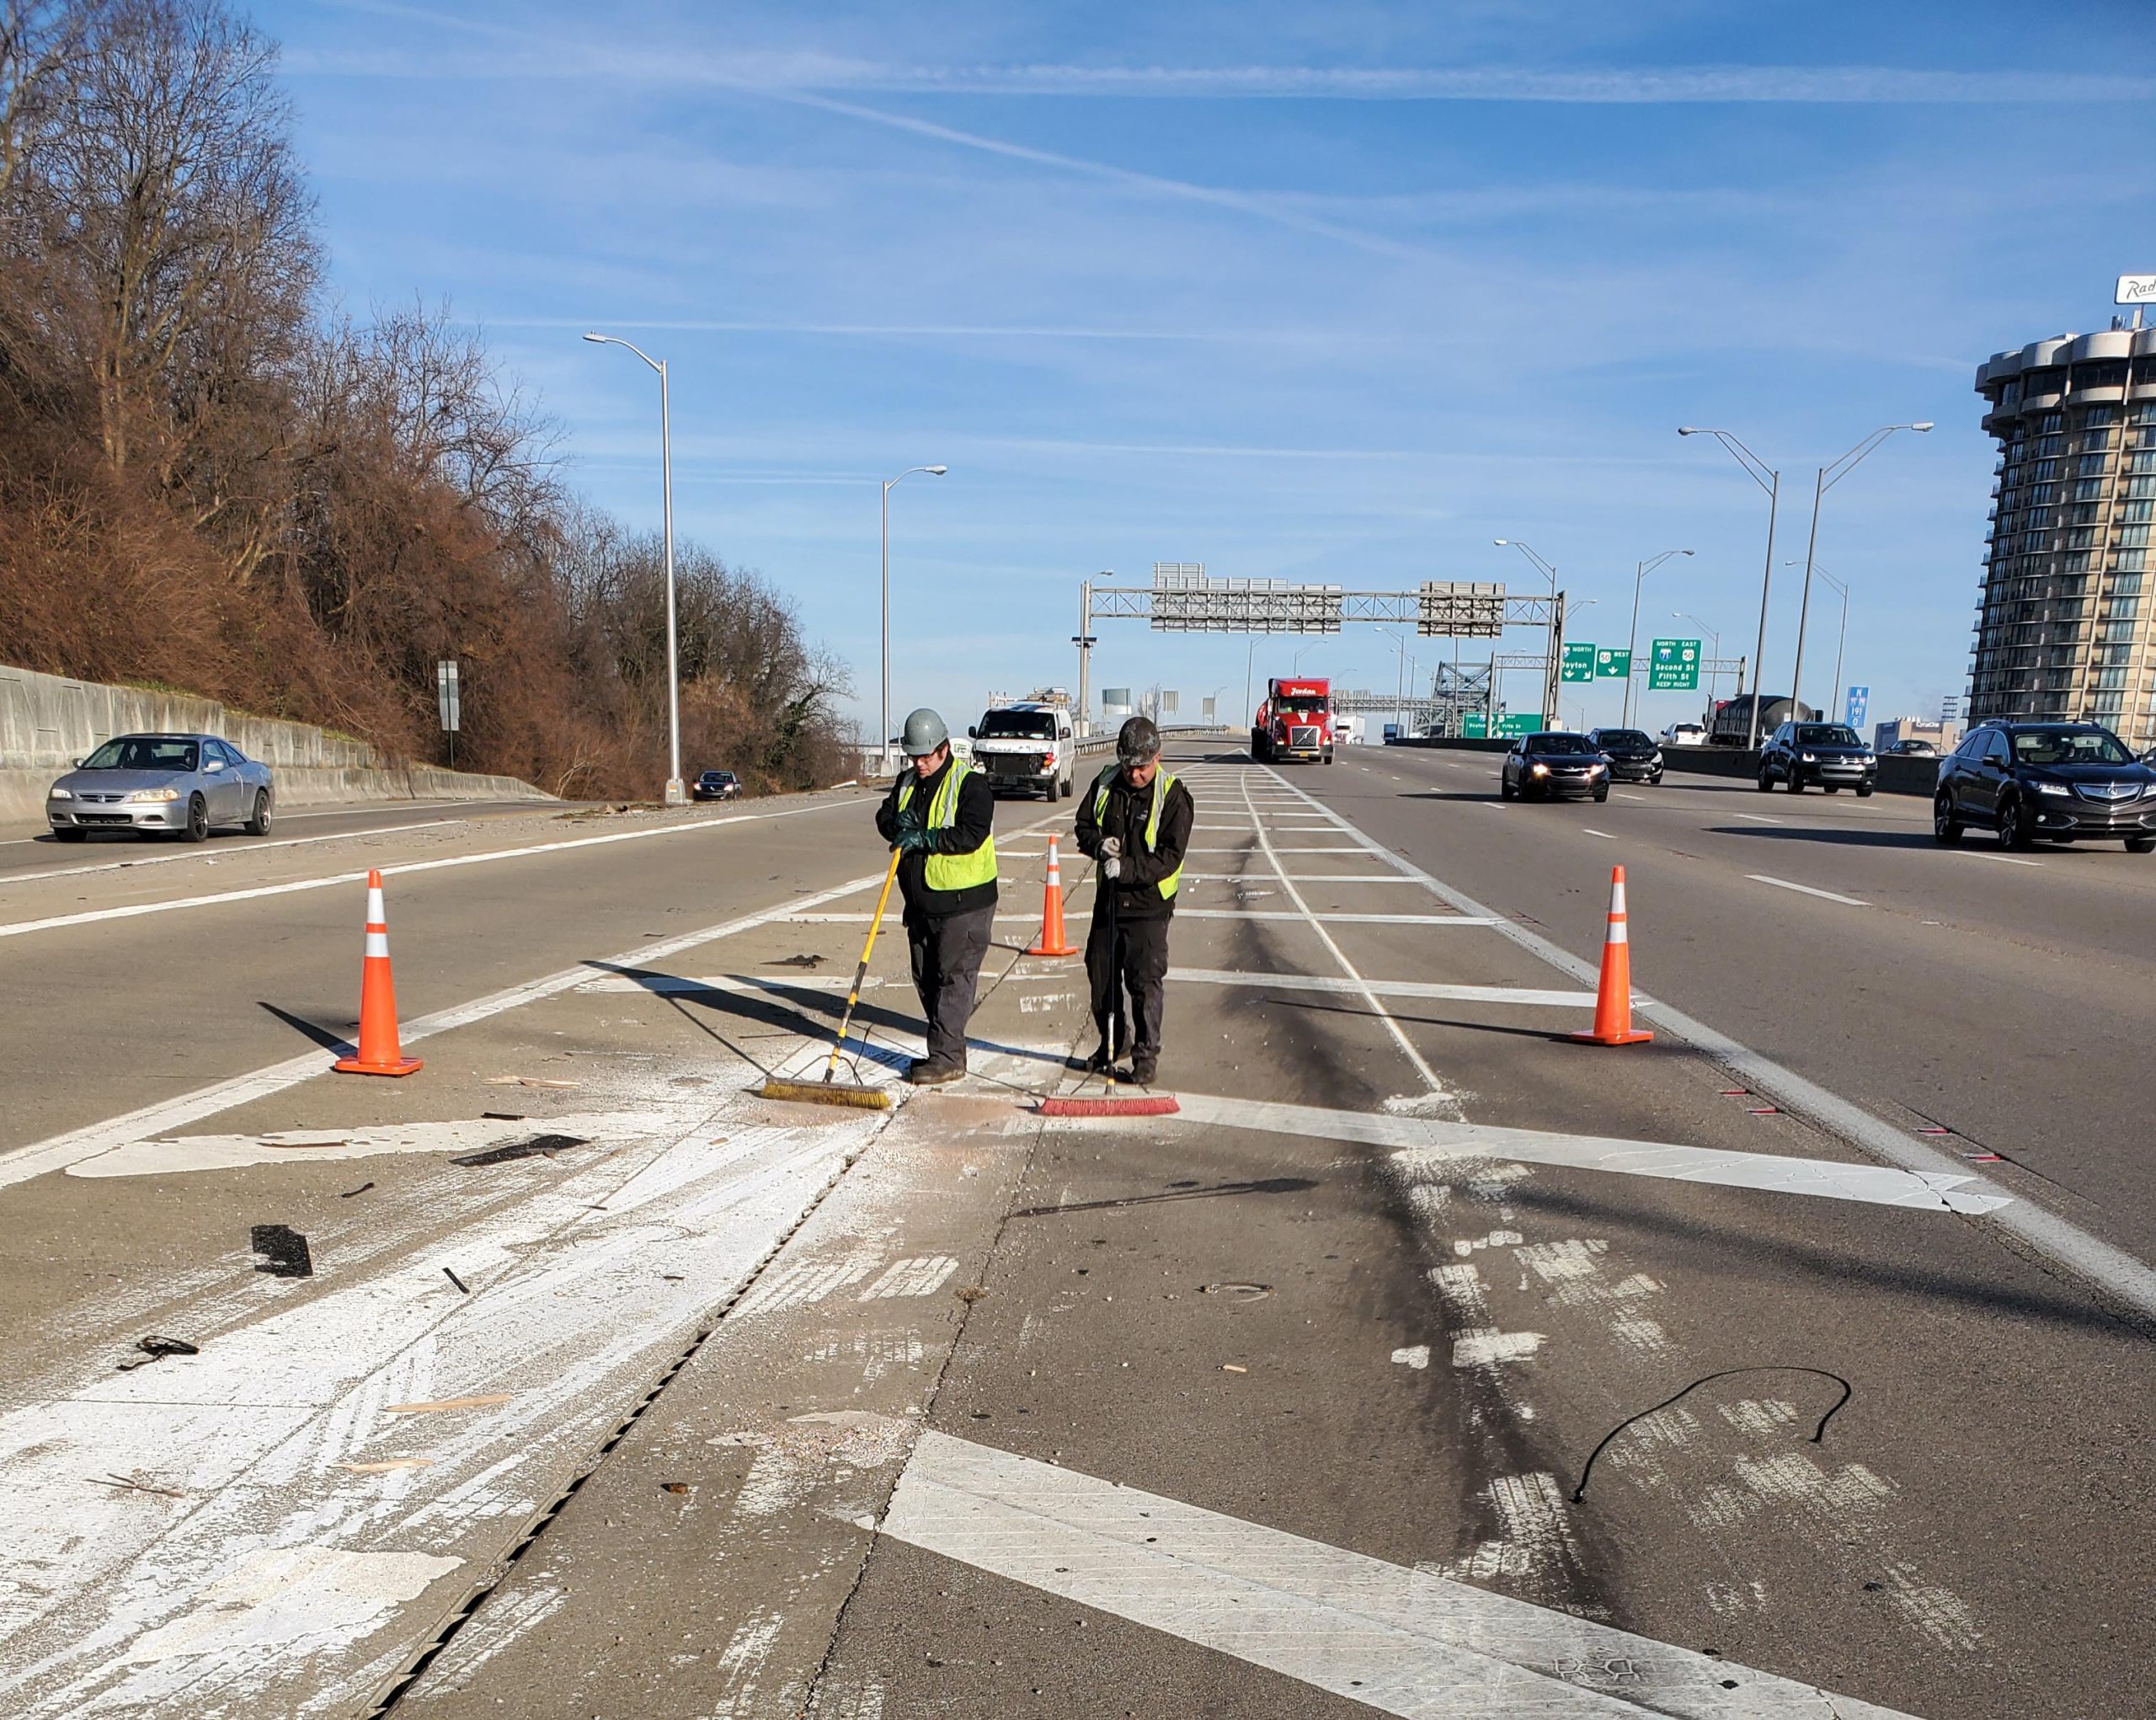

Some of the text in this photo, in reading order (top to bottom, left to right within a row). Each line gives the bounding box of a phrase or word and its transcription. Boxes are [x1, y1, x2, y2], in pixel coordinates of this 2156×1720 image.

[1291, 687, 1315, 696] Jordan
[1856, 688, 1862, 697] N
[1851, 707, 1862, 716] 191
[1853, 718, 1859, 726] 0
